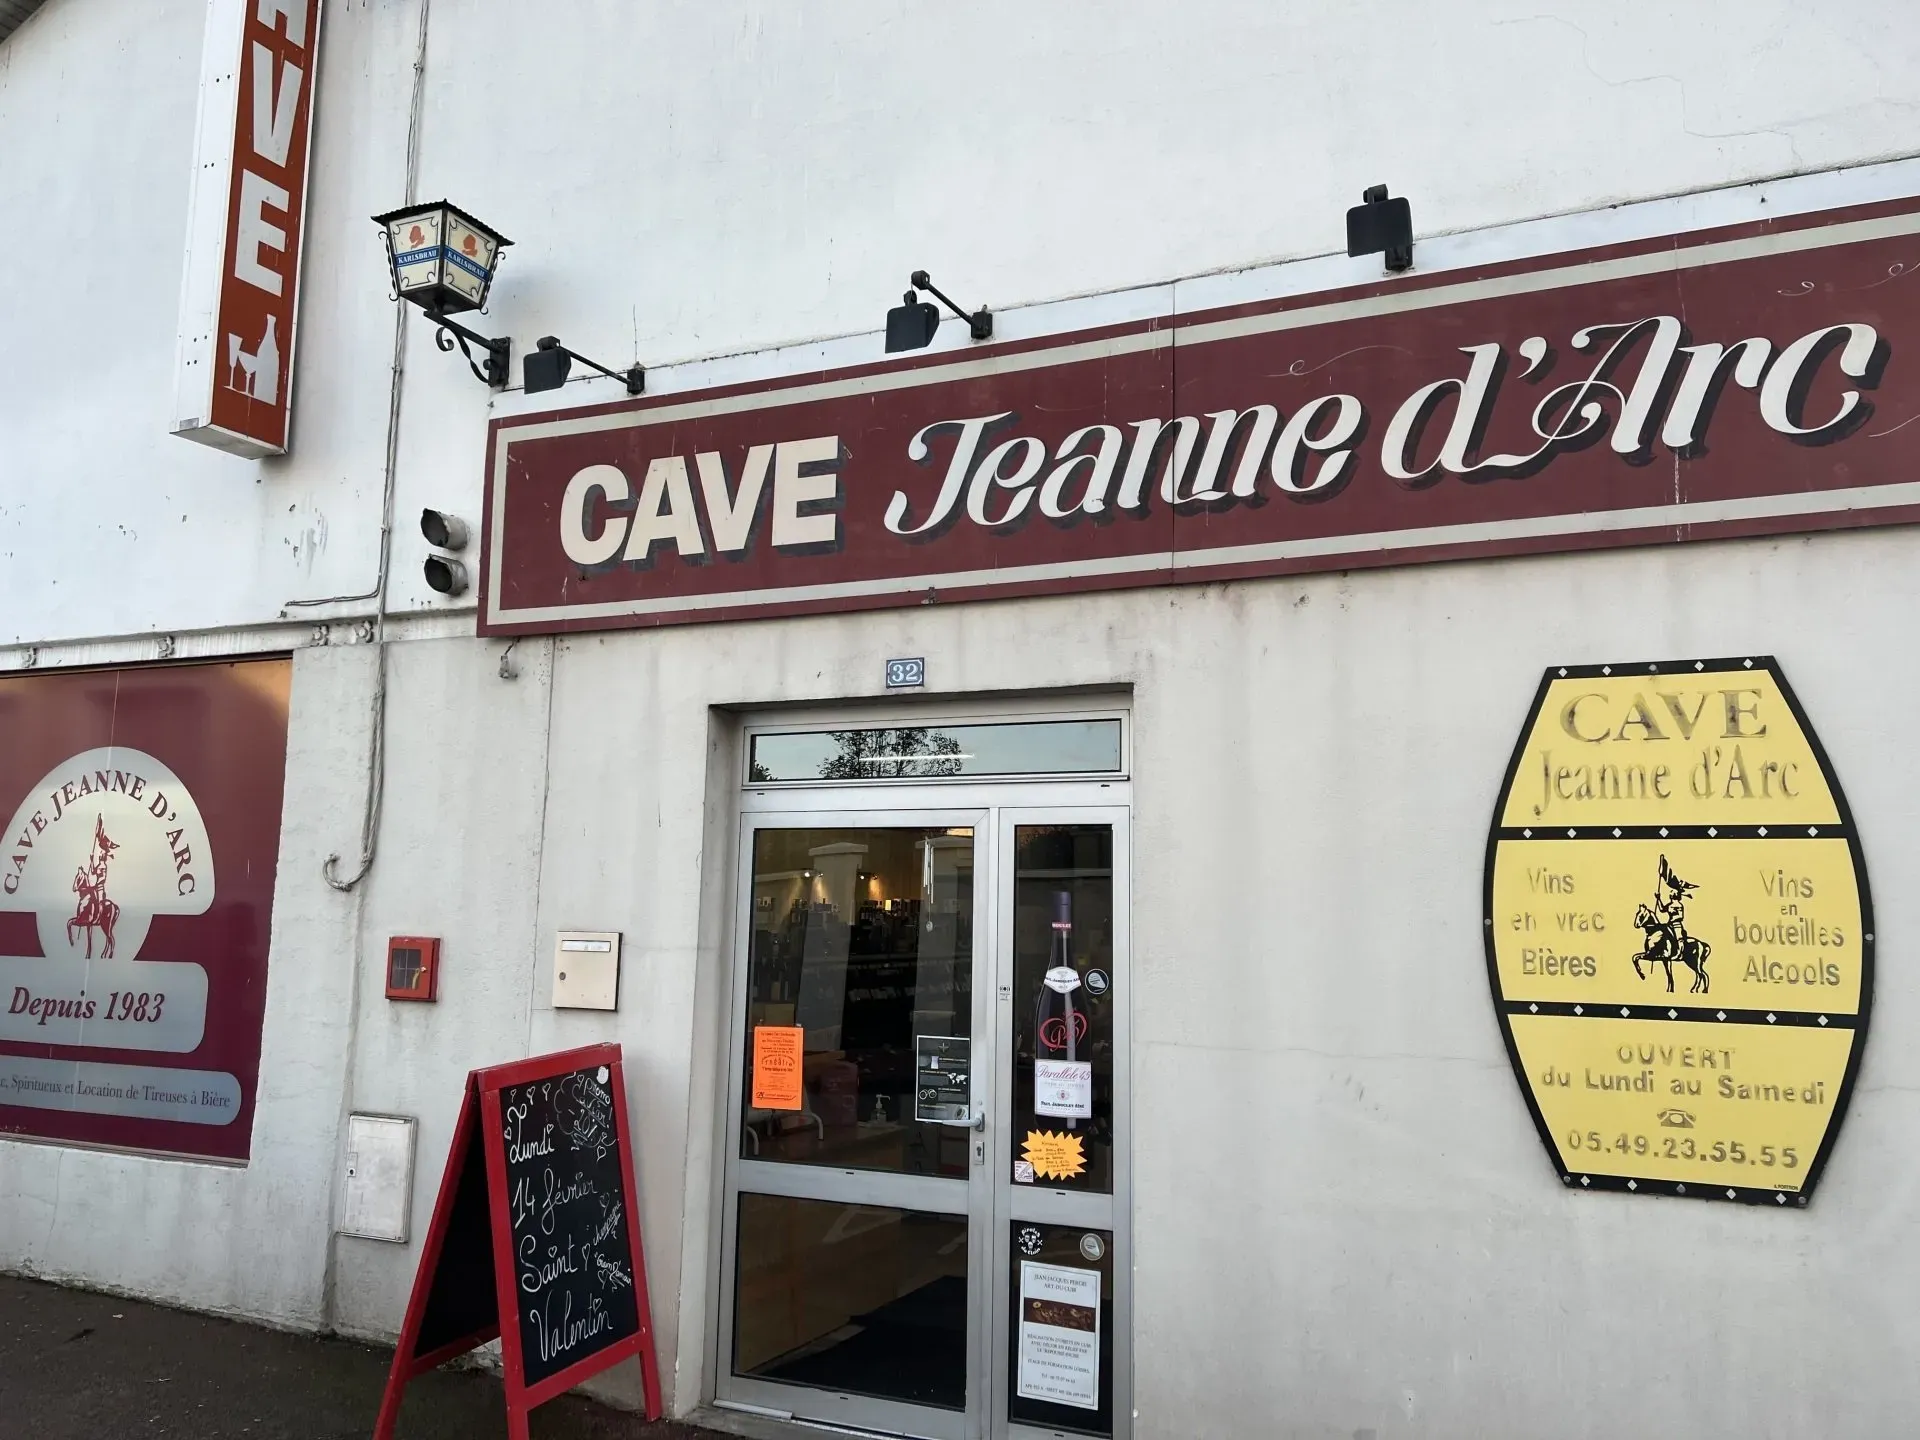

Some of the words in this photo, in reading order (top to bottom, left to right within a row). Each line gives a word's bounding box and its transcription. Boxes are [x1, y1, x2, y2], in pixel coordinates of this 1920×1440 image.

[560, 435, 839, 565] CAVE
[883, 394, 1362, 534] Jeanne
[1381, 315, 1877, 479] d'Arc
[891, 664, 919, 682] 32
[1560, 688, 1767, 743] CAVE
[1534, 749, 1671, 816] Jeanne
[1689, 744, 1800, 801] d'Arc
[4, 810, 48, 895] CAVE
[50, 770, 147, 822] JEANNE
[148, 791, 196, 896] D'ARC
[1526, 867, 1575, 895] Vins
[1759, 868, 1814, 899] Vins
[1510, 912, 1537, 932] en
[1556, 910, 1605, 933] vrac
[1780, 903, 1798, 917] en
[1733, 916, 1845, 948] bouteilles
[1522, 947, 1597, 978] Bières
[1742, 955, 1841, 987] Alcools
[8, 986, 97, 1026] Depuis
[104, 991, 165, 1023] 1983
[1616, 1042, 1736, 1070] OUVERT
[11, 1074, 62, 1093] Spiritueux
[64, 1082, 75, 1095] et
[77, 1080, 123, 1099] Location
[125, 1084, 139, 1099] de
[142, 1086, 188, 1104] Tireuses
[190, 1092, 198, 1105] à
[201, 1090, 231, 1108] Bière
[1541, 1065, 1570, 1086] du
[1585, 1068, 1654, 1094] Lundi
[1670, 1079, 1702, 1096] au
[1718, 1075, 1824, 1105] Samedi
[506, 1103, 556, 1164] Lundi
[1567, 1130, 1799, 1169] 05.49.23.55.55
[512, 1176, 536, 1230] 14
[541, 1167, 599, 1236] février
[519, 1233, 578, 1293] Saint
[529, 1289, 614, 1362] Valentin
